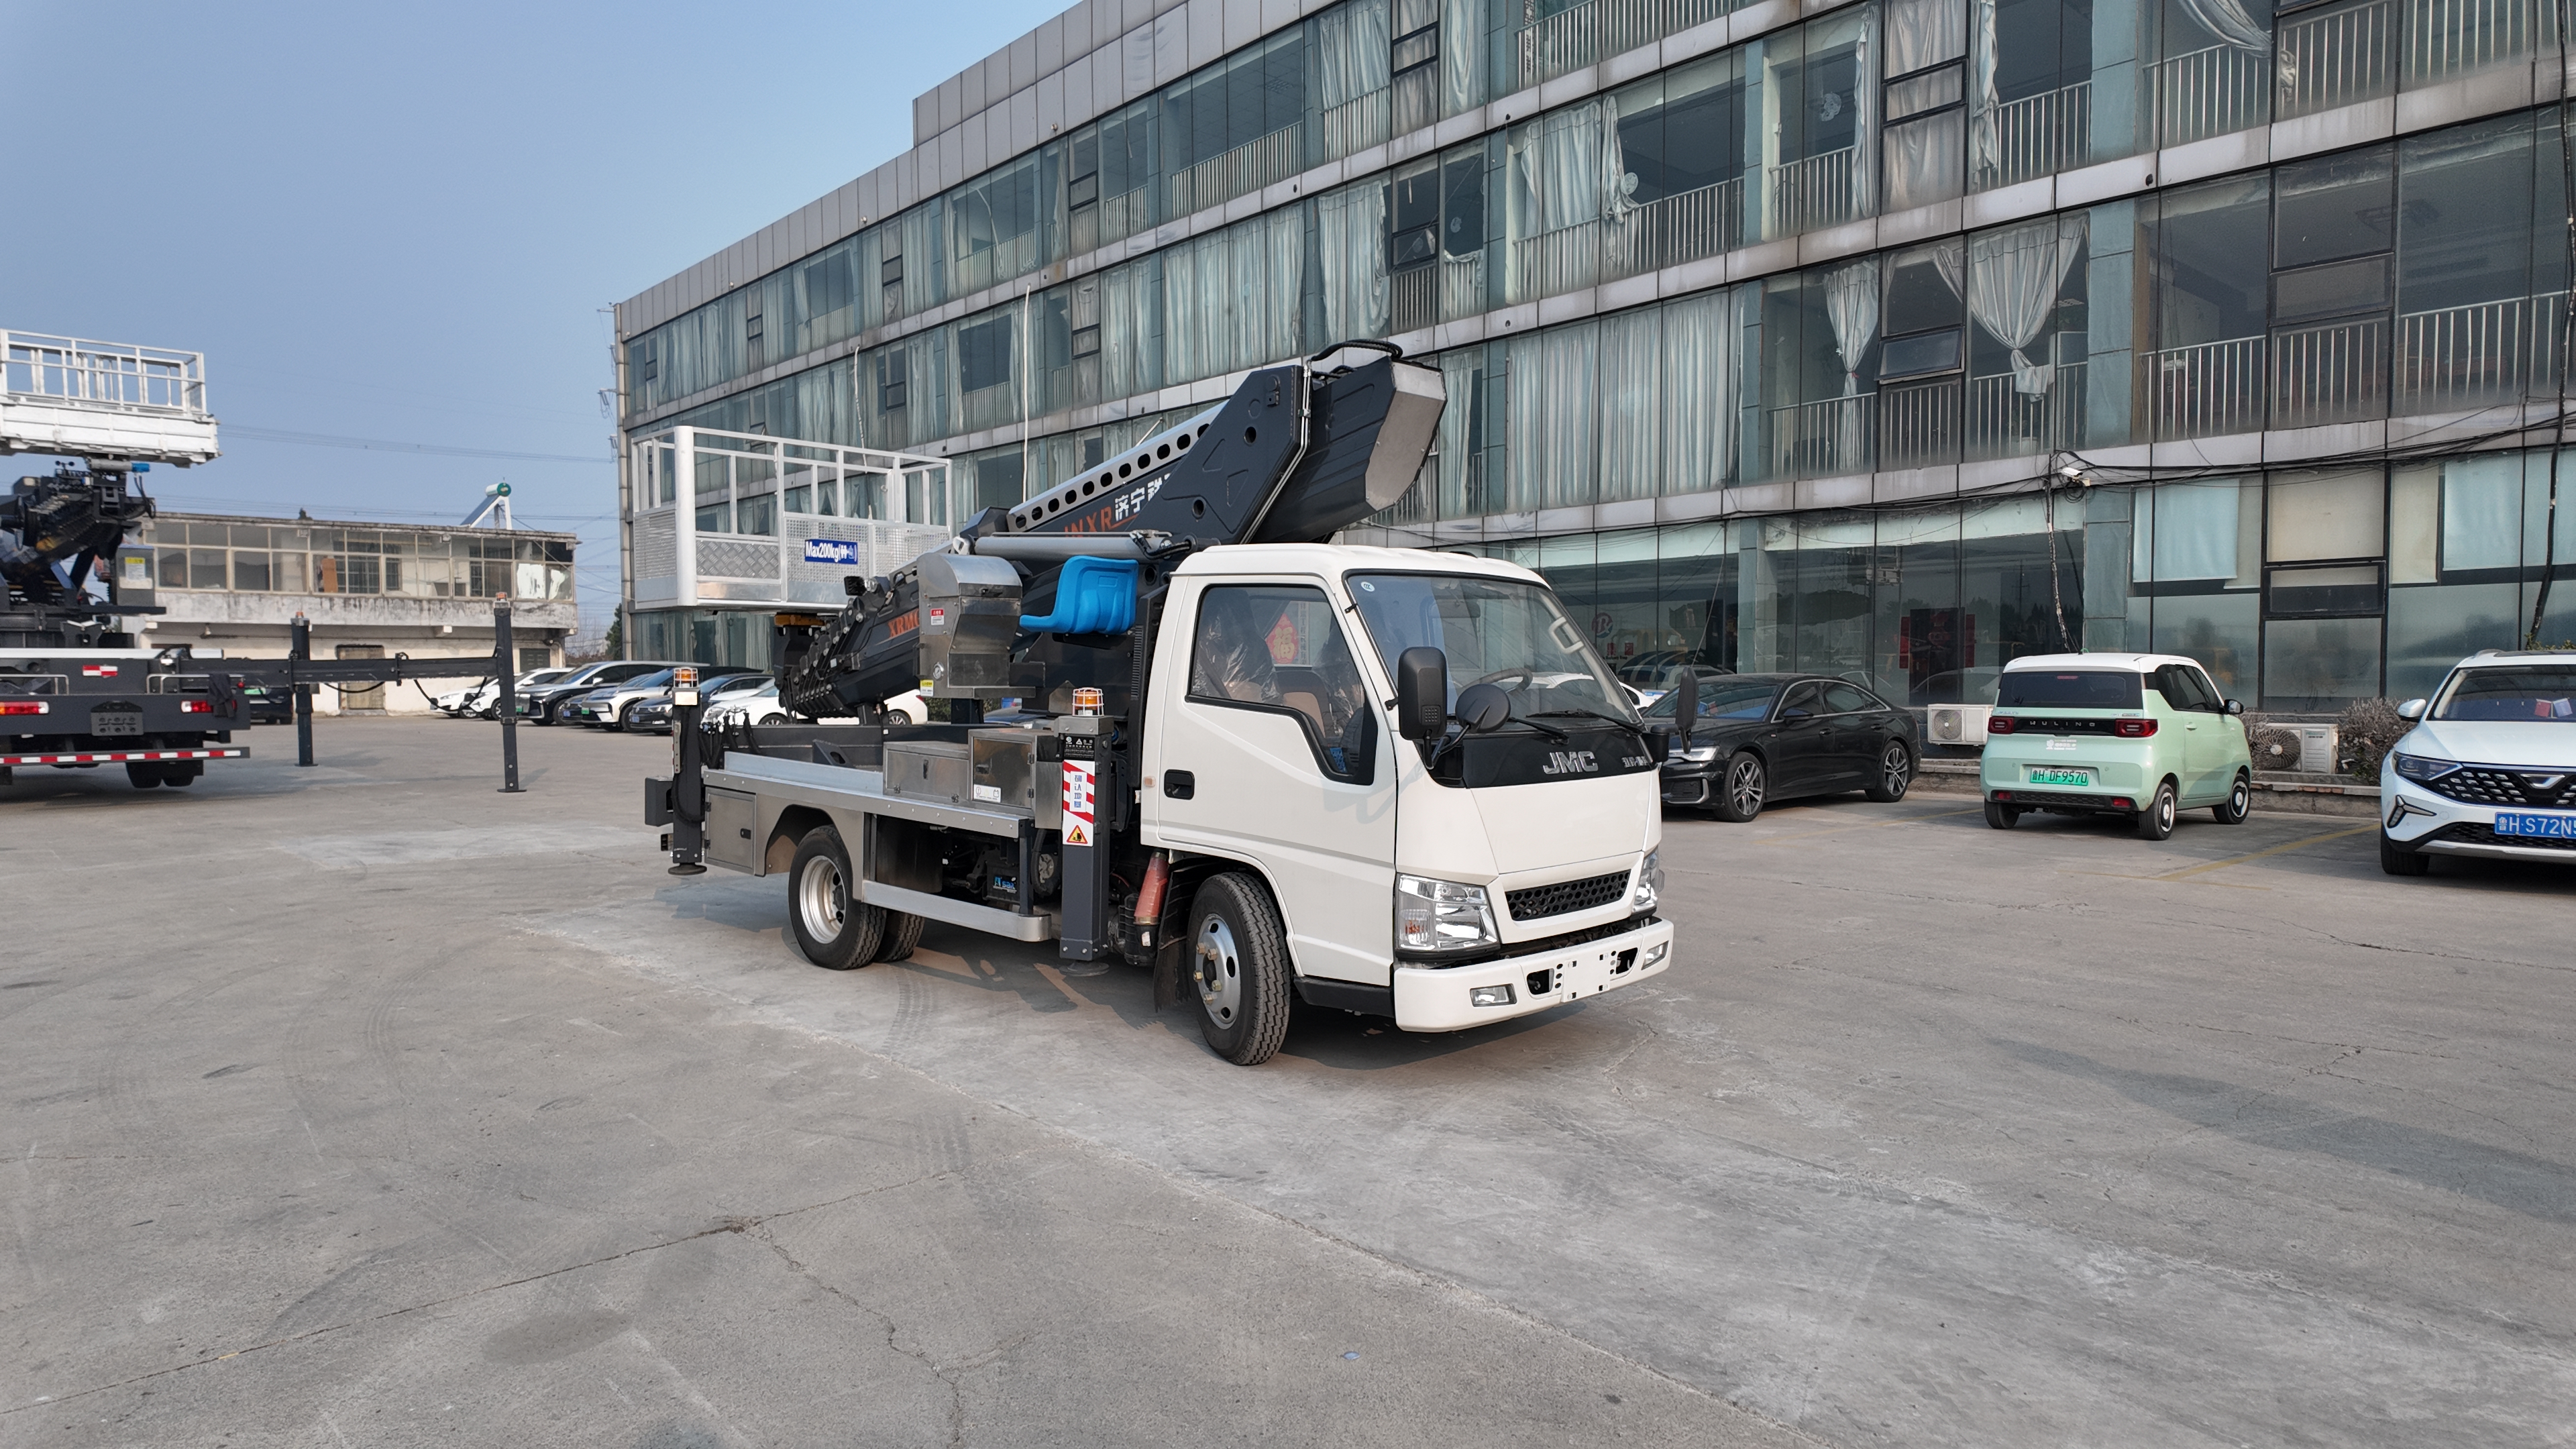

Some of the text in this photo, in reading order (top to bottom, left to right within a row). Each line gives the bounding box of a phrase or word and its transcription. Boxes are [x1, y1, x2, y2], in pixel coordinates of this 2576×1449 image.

[1114, 472, 1172, 522] 济宁祥
[1273, 627, 1295, 659] 福
[1543, 751, 1599, 774] JMC
[2498, 816, 2576, 835] 鲁H·S72N
